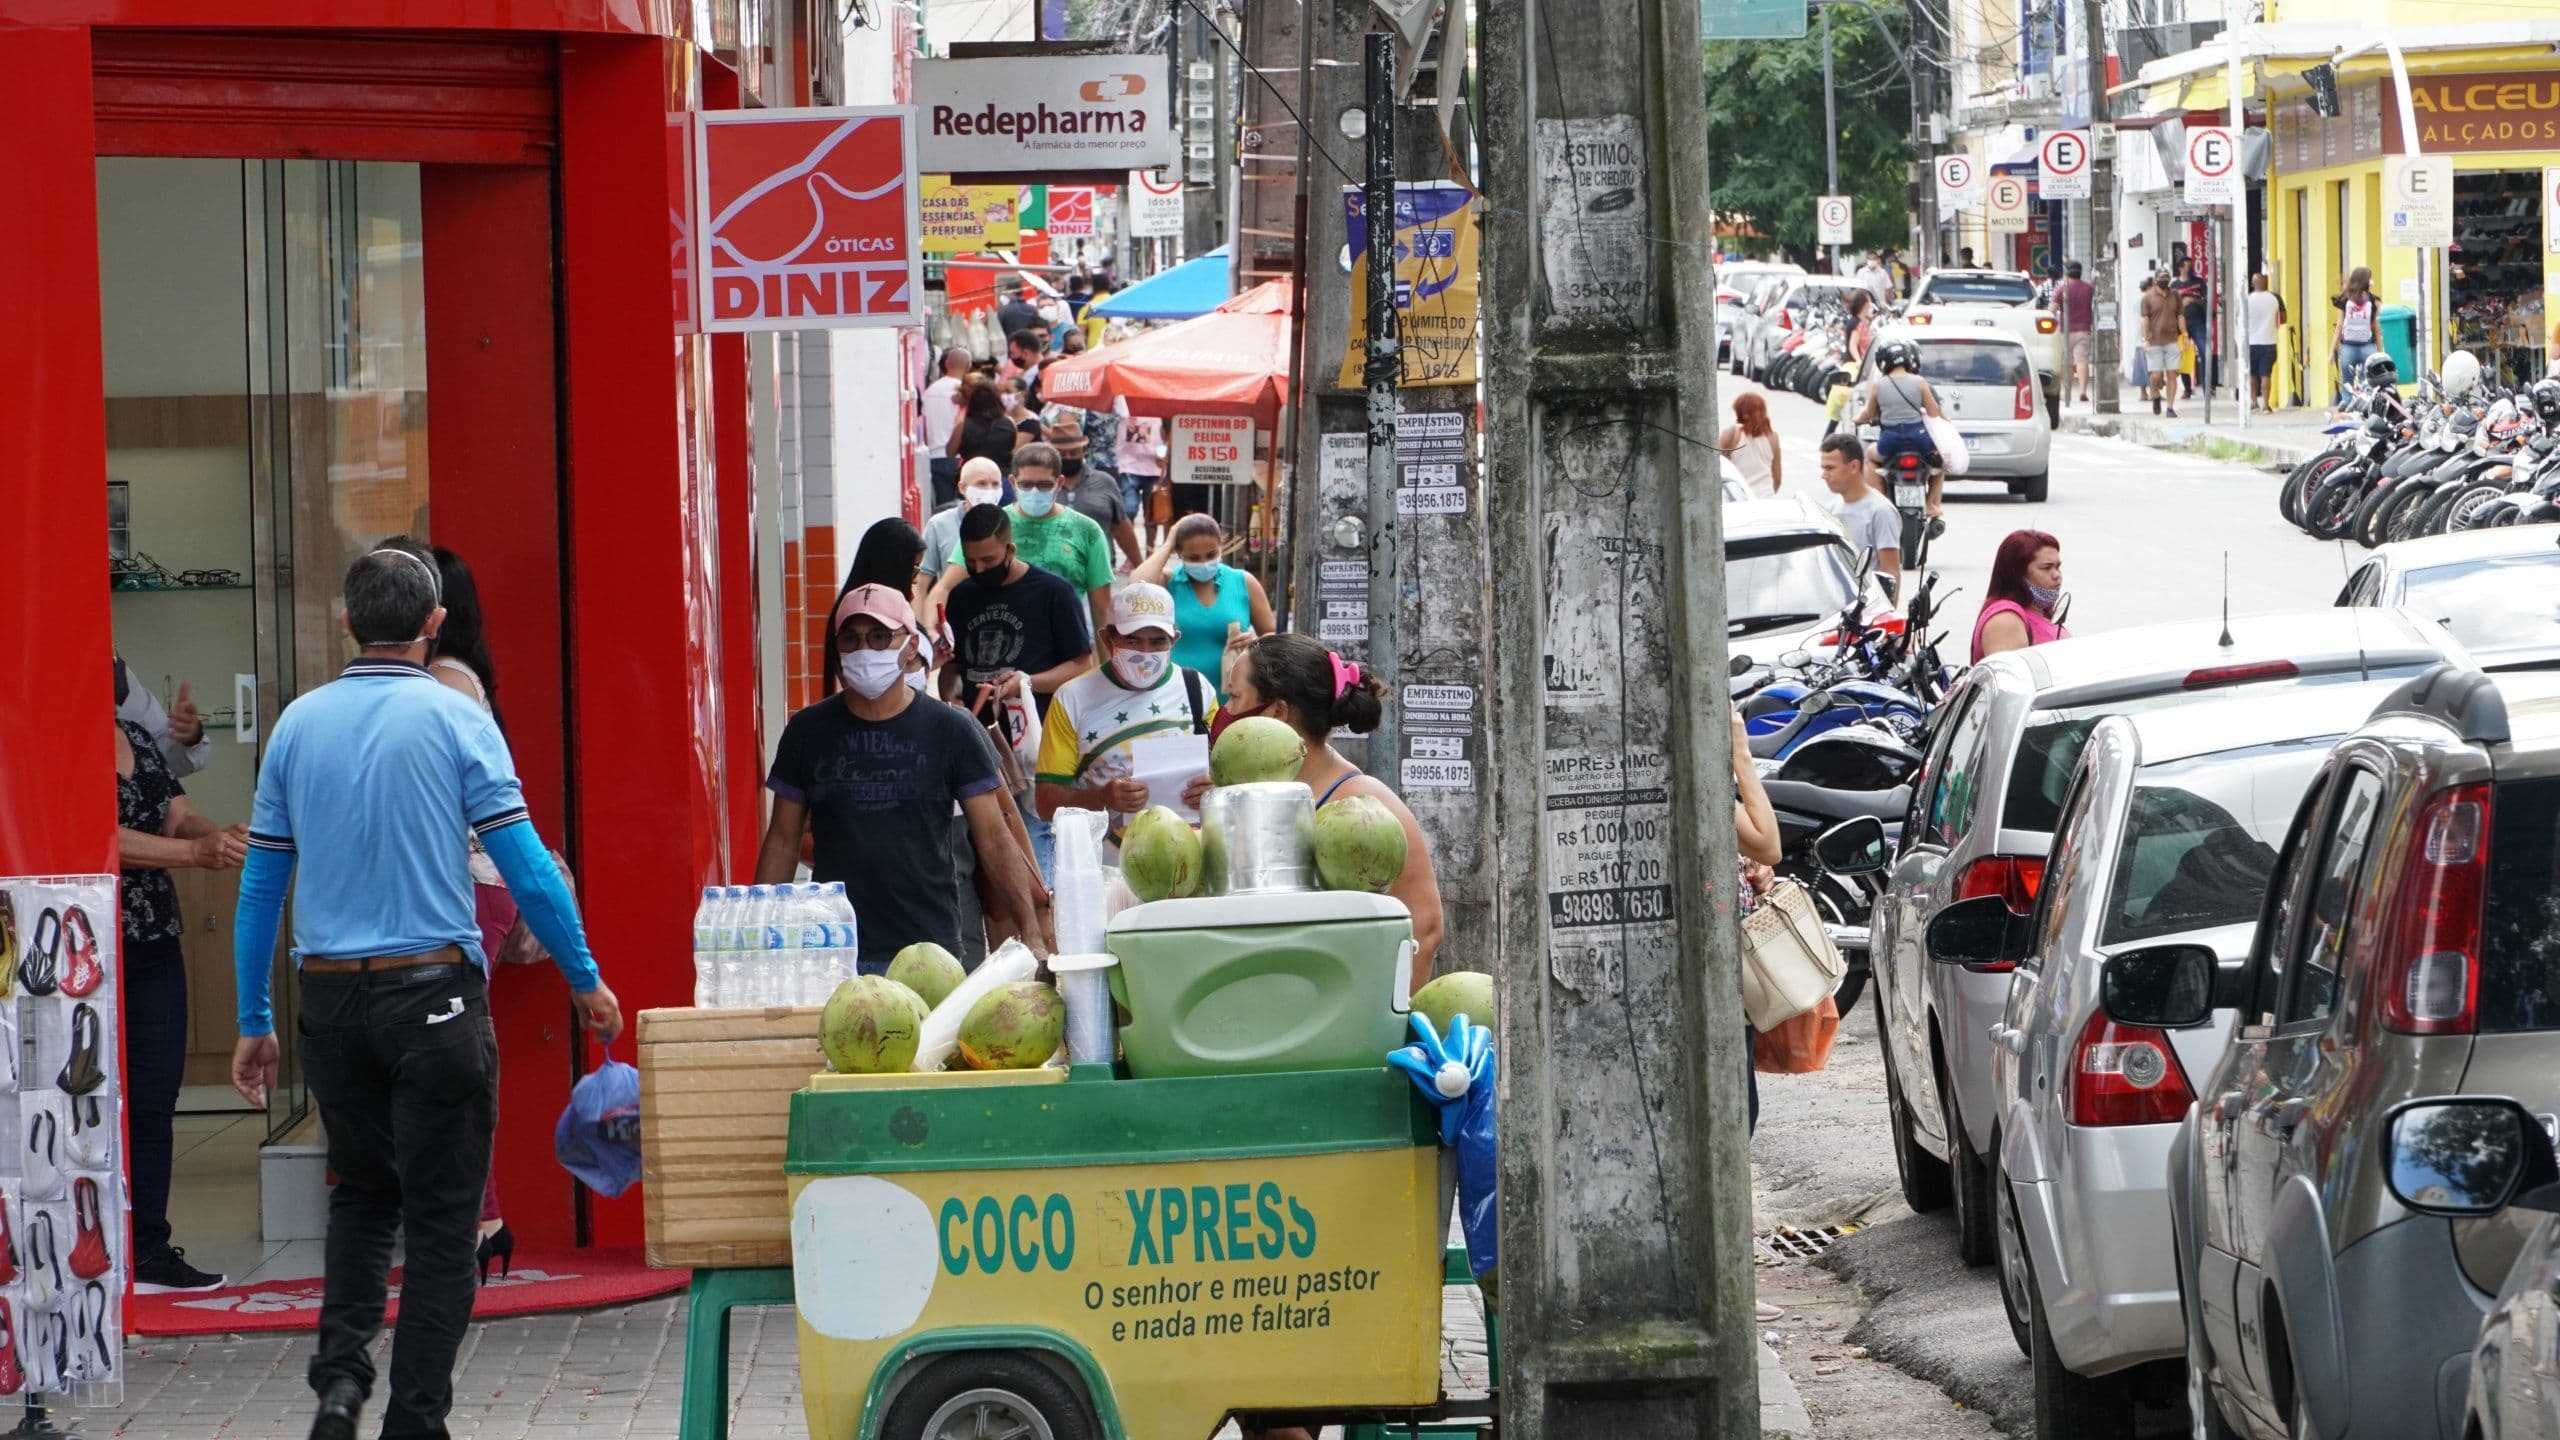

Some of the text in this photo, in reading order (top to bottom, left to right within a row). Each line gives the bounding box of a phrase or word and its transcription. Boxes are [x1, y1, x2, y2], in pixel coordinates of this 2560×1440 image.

[2411, 82, 2560, 112] ALCEU
[933, 103, 1146, 142] Redepharma
[2423, 120, 2556, 144] ALÇADOS
[1024, 139, 1146, 150] A farmácia do menor preço
[2057, 142, 2072, 165] E
[2205, 140, 2221, 166] E
[1579, 171, 1592, 187] DE
[1950, 164, 1961, 182] E
[2411, 170, 2428, 193] E
[922, 198, 969, 207] CASA DAS
[2000, 186, 2014, 203] E
[1831, 206, 1840, 220] E
[1050, 225, 1092, 235] DINIZ
[1991, 218, 2024, 226] MOTOS
[932, 226, 984, 235] PERFUMES
[824, 236, 895, 253] ÓTICAS
[713, 269, 909, 320] DINIZ
[1450, 317, 1466, 329] DO
[1053, 371, 1092, 393] ITAIPAVA
[1178, 418, 1247, 429] ESPETINHO DO
[1431, 440, 1442, 448] NA
[1443, 440, 1463, 449] HORA
[1405, 492, 1465, 508] 99956.1875
[967, 610, 1024, 631] CERVEJEIRO
[1326, 624, 1368, 636] 99956.187
[1407, 686, 1471, 699] EMPRÉSTIMO
[1406, 712, 1471, 721] DINHEIRO NA HORA
[1546, 753, 1661, 774] EMPRÉSIMO
[1410, 765, 1469, 780] 99956.1875
[1568, 771, 1601, 781] CARTÃO
[1585, 809, 1621, 820] PEGUE
[1557, 820, 1655, 846] R$ 1.000,00
[1578, 851, 1613, 861] PAGUE
[1560, 859, 1660, 886] DE R$ 107,00
[940, 1193, 1075, 1276] COCO
[1085, 1265, 1381, 1309] O senhor e meu pastor
[1112, 1300, 1331, 1342] e nada me faltará
